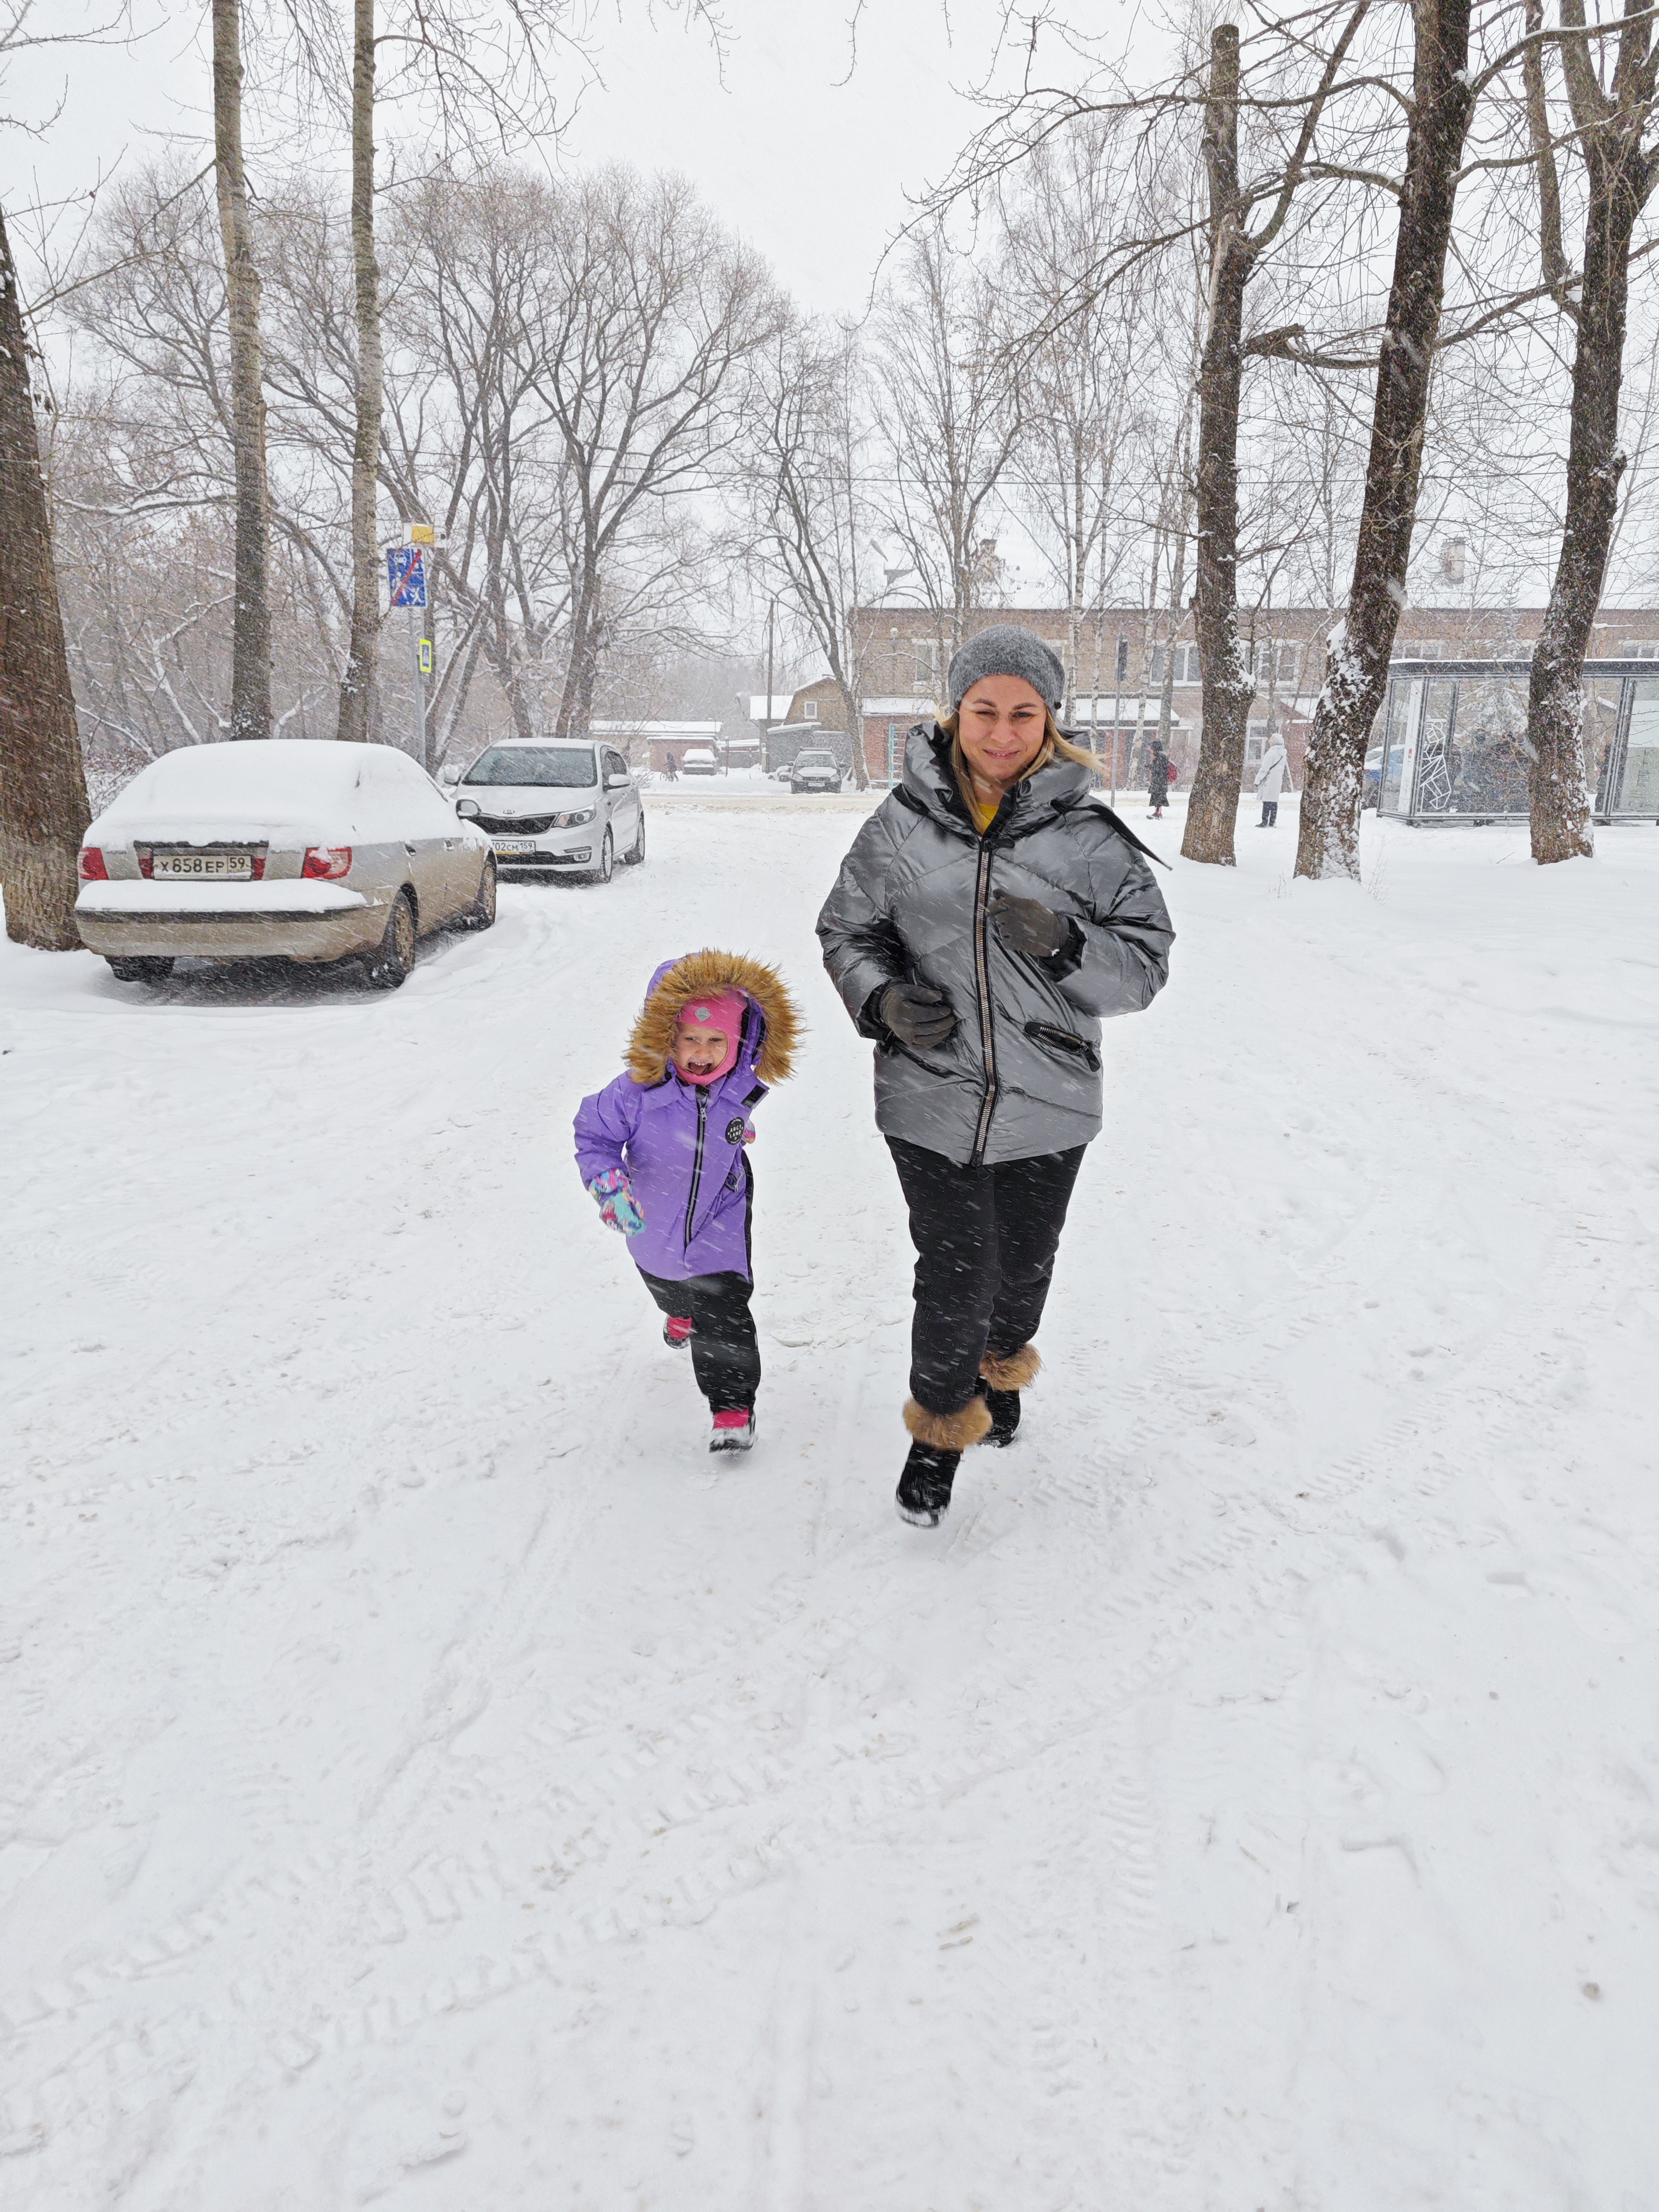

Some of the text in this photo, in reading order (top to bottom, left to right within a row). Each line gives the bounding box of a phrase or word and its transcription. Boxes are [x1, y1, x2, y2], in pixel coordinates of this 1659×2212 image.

[493, 842, 518, 851] 02СМ
[229, 857, 245, 869] 59
[730, 1124, 741, 1133] ARCT
[730, 1130, 741, 1138] LAND
